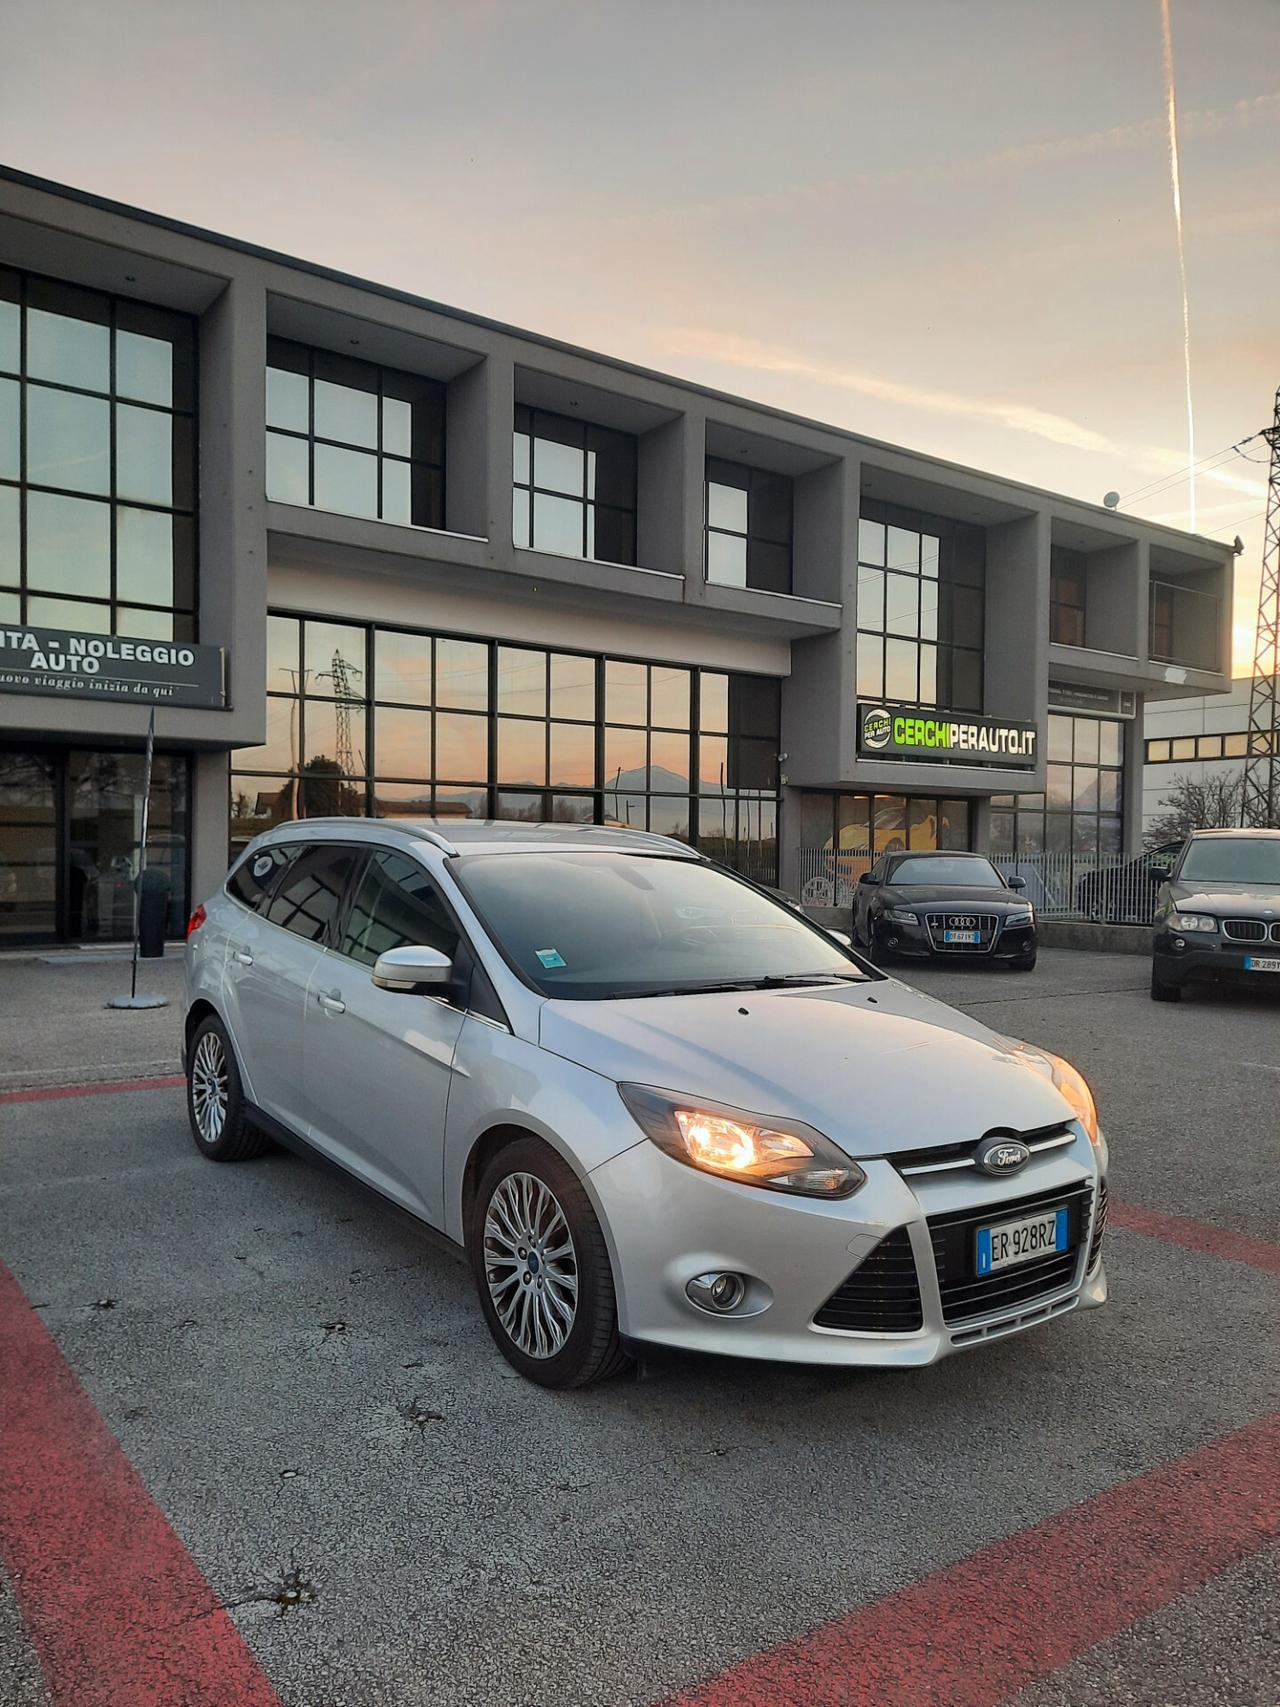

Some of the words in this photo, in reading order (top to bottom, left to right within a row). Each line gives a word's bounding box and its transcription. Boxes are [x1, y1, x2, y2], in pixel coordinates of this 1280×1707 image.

[69, 638, 194, 666] NOLEGGIO
[30, 652, 100, 674] AUTO
[35, 675, 84, 690] viaggio
[89, 679, 129, 693] inizia
[133, 683, 149, 694] da
[864, 718, 891, 733] CERCHI
[864, 730, 876, 740] PER
[876, 726, 891, 736] AUTO
[894, 718, 1036, 755] CERCHIPERAUTO.IT
[997, 1148, 1021, 1166] Ford
[991, 1232, 1009, 1262] ER
[1013, 1221, 1056, 1255] 928RZ
